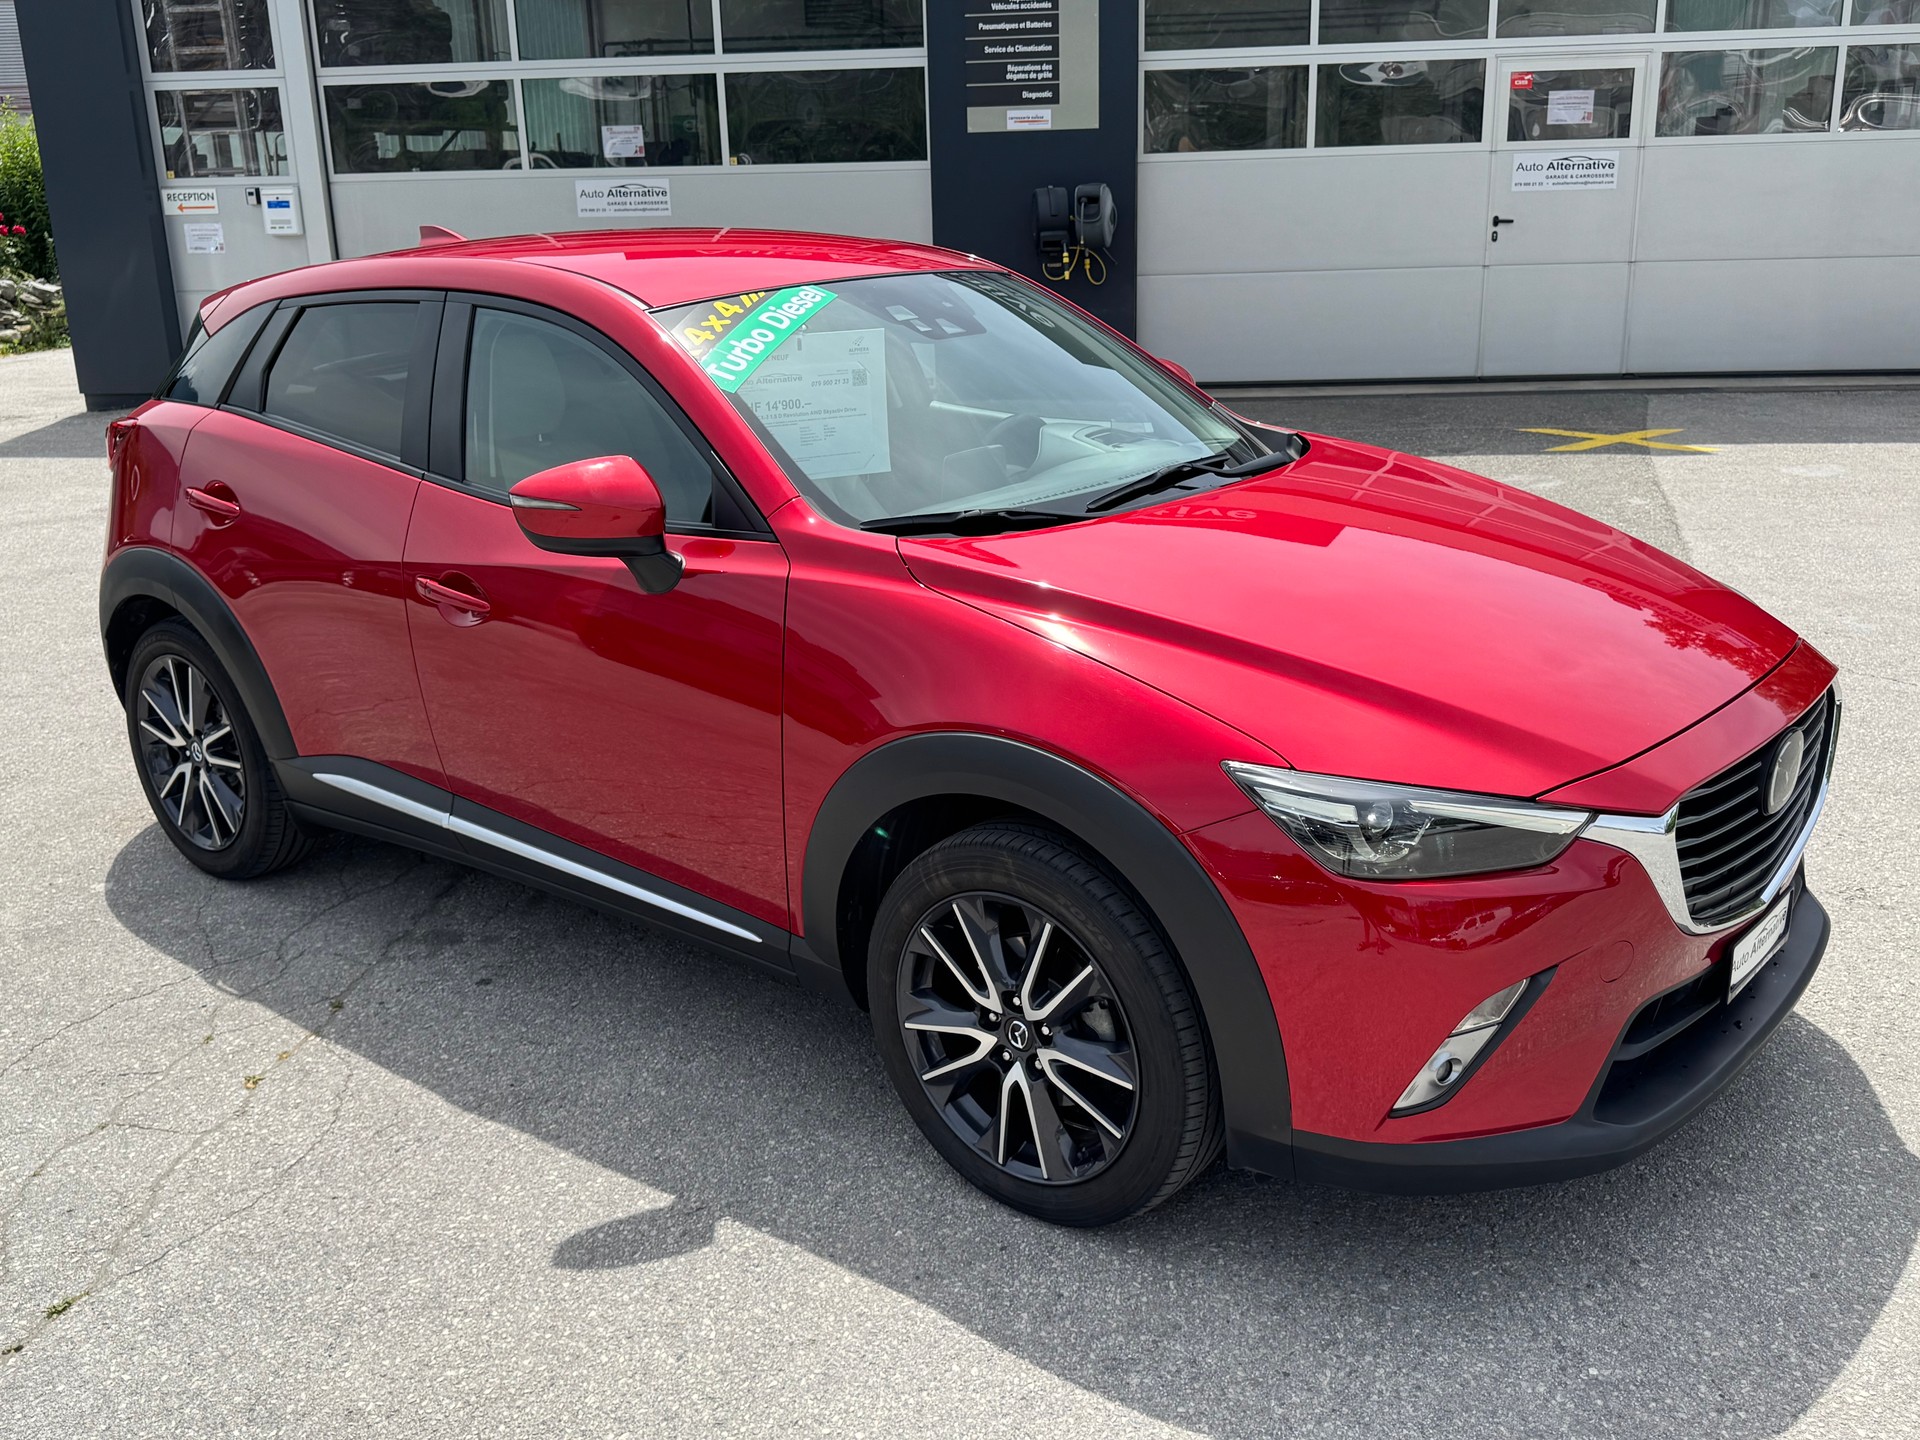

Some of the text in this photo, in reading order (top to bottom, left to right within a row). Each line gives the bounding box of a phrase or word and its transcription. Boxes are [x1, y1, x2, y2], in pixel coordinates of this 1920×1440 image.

[991, 1, 1052, 10] Véhicules accidentés
[978, 22, 1018, 30] Pneumatiques
[1015, 44, 1052, 52] Climatisation
[1007, 64, 1041, 72] Réparations
[1038, 71, 1052, 80] grêle
[1022, 91, 1052, 99] Diagnostic
[1516, 161, 1615, 172] Auto Alternative
[167, 193, 214, 201] RECEPTION
[580, 189, 667, 198] Auto Alternative
[706, 286, 827, 380] Turbo Diesel
[756, 375, 802, 385] Alternative
[1732, 910, 1787, 972] Auto Alternative
